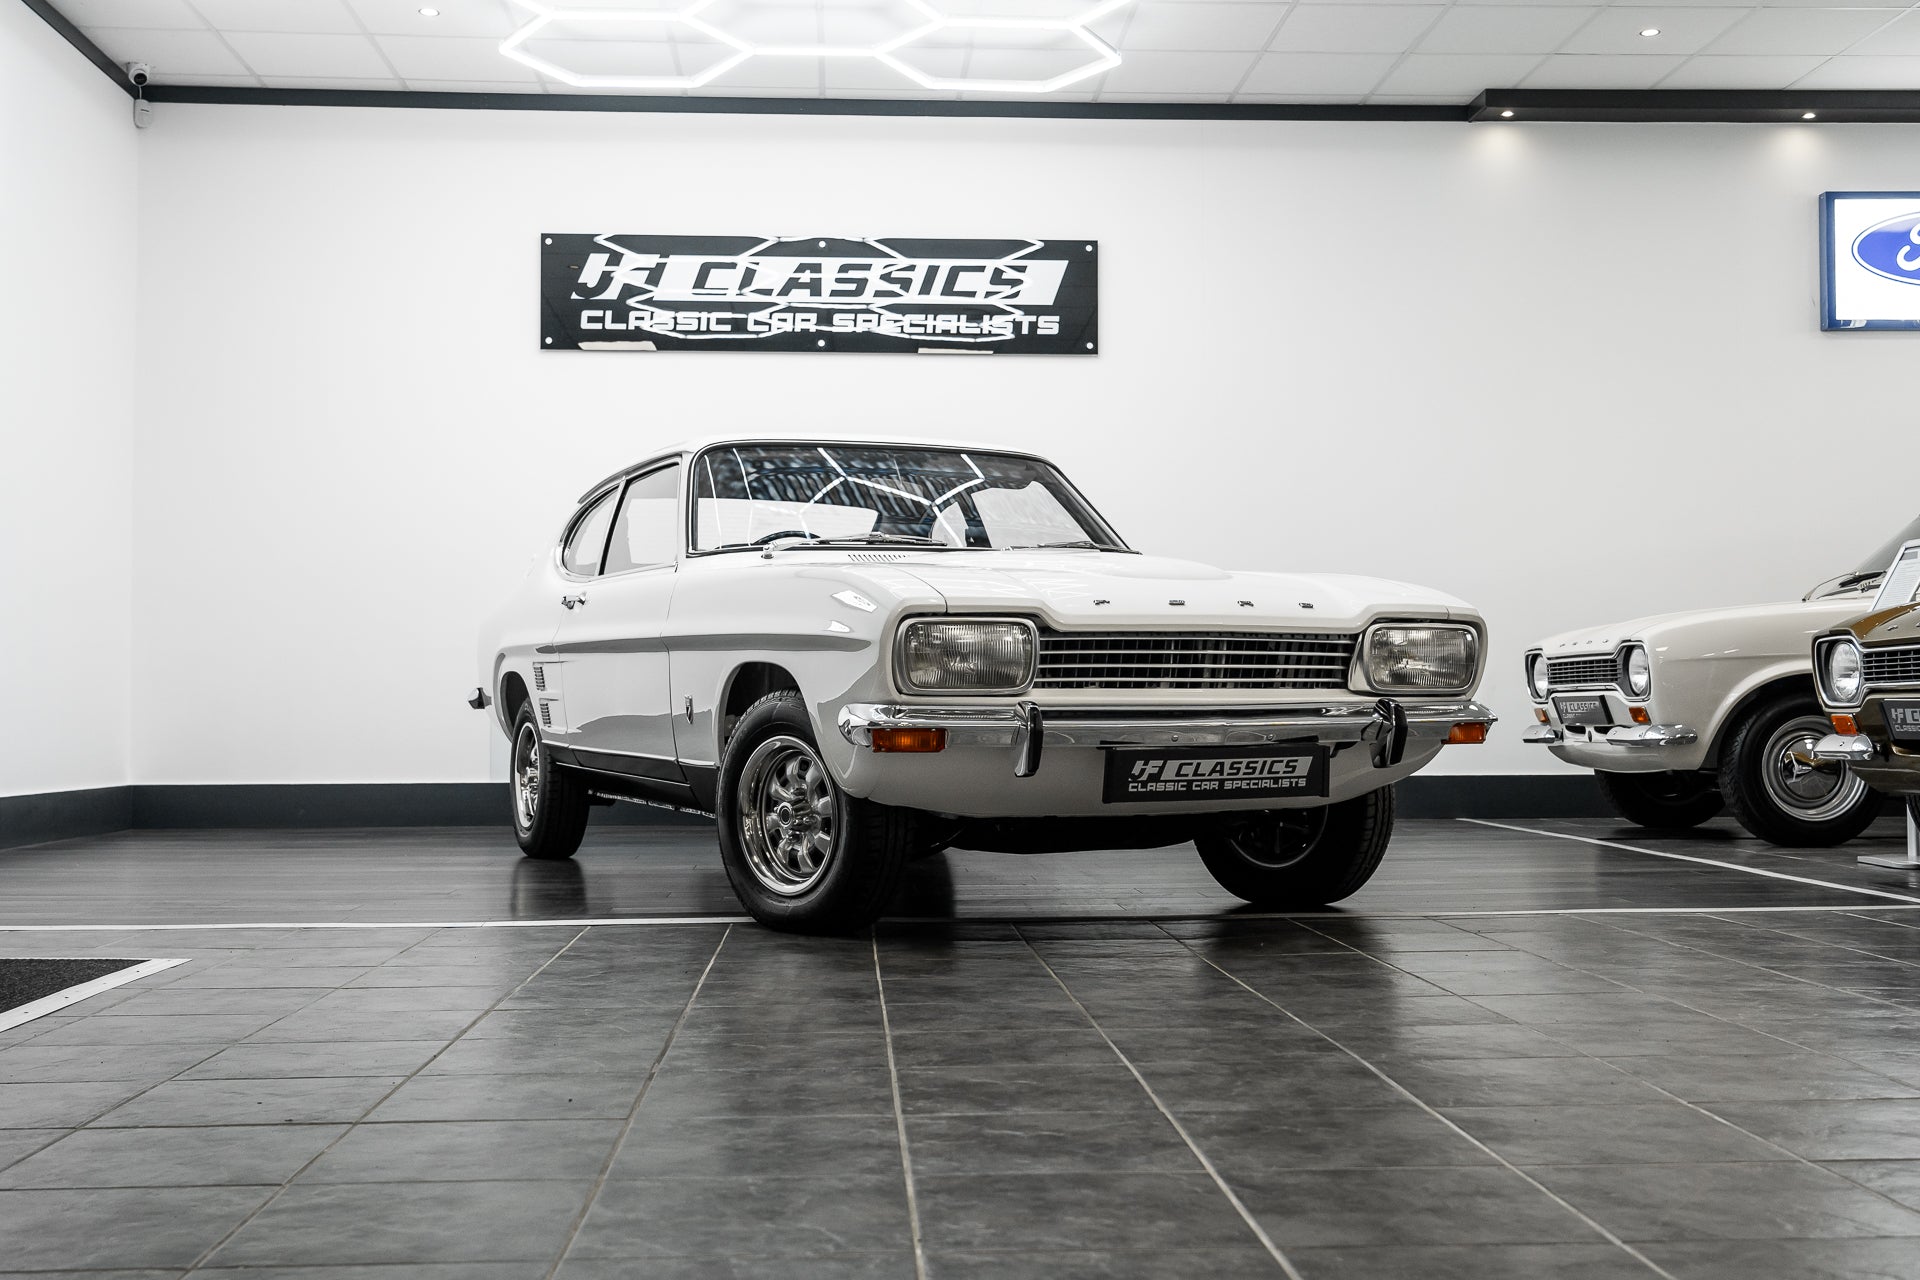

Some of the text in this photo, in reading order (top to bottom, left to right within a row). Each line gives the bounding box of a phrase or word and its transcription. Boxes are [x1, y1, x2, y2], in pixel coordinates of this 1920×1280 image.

[691, 261, 1028, 299] CLASSICS
[580, 309, 1061, 335] CLASSIC CAR SPECIALISTS
[1174, 758, 1299, 778] CLASSICS
[1128, 777, 1307, 792] CLASSIC CAR SPECIALISTS
